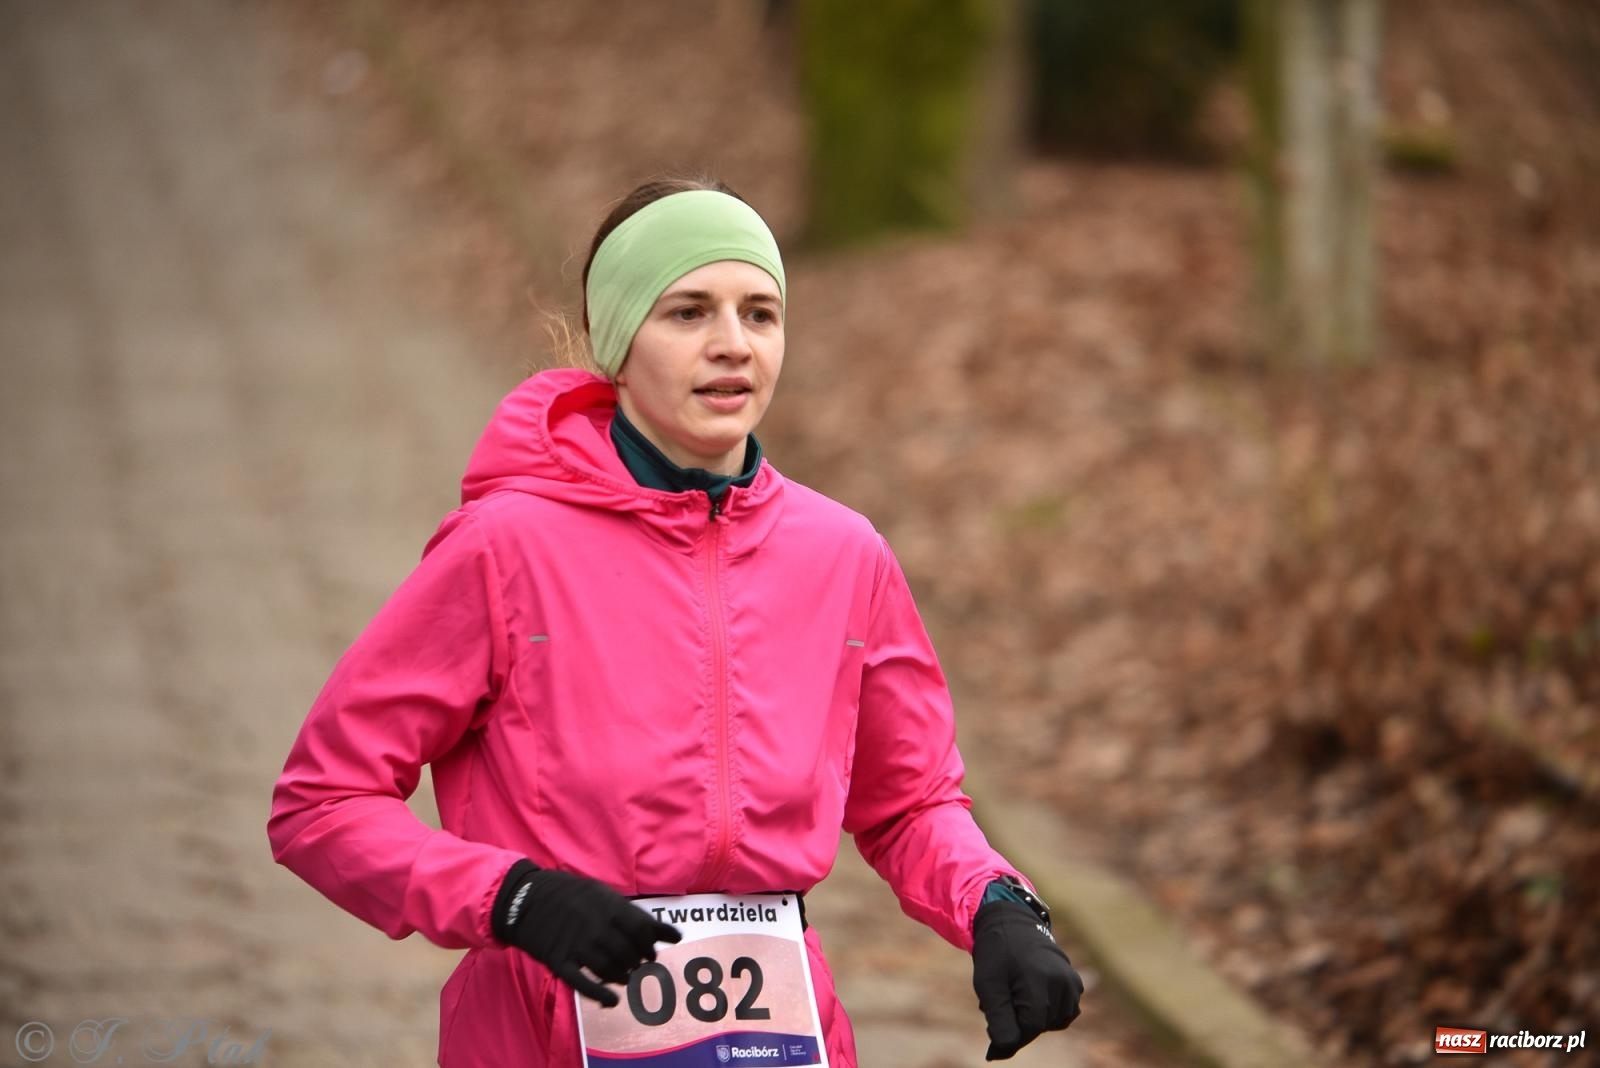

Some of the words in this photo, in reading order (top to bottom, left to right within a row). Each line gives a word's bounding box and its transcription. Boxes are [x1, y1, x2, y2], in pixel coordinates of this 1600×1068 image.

[652, 902, 777, 924] Twardziela
[626, 956, 771, 1026] 082
[731, 1046, 779, 1058] Racibórz
